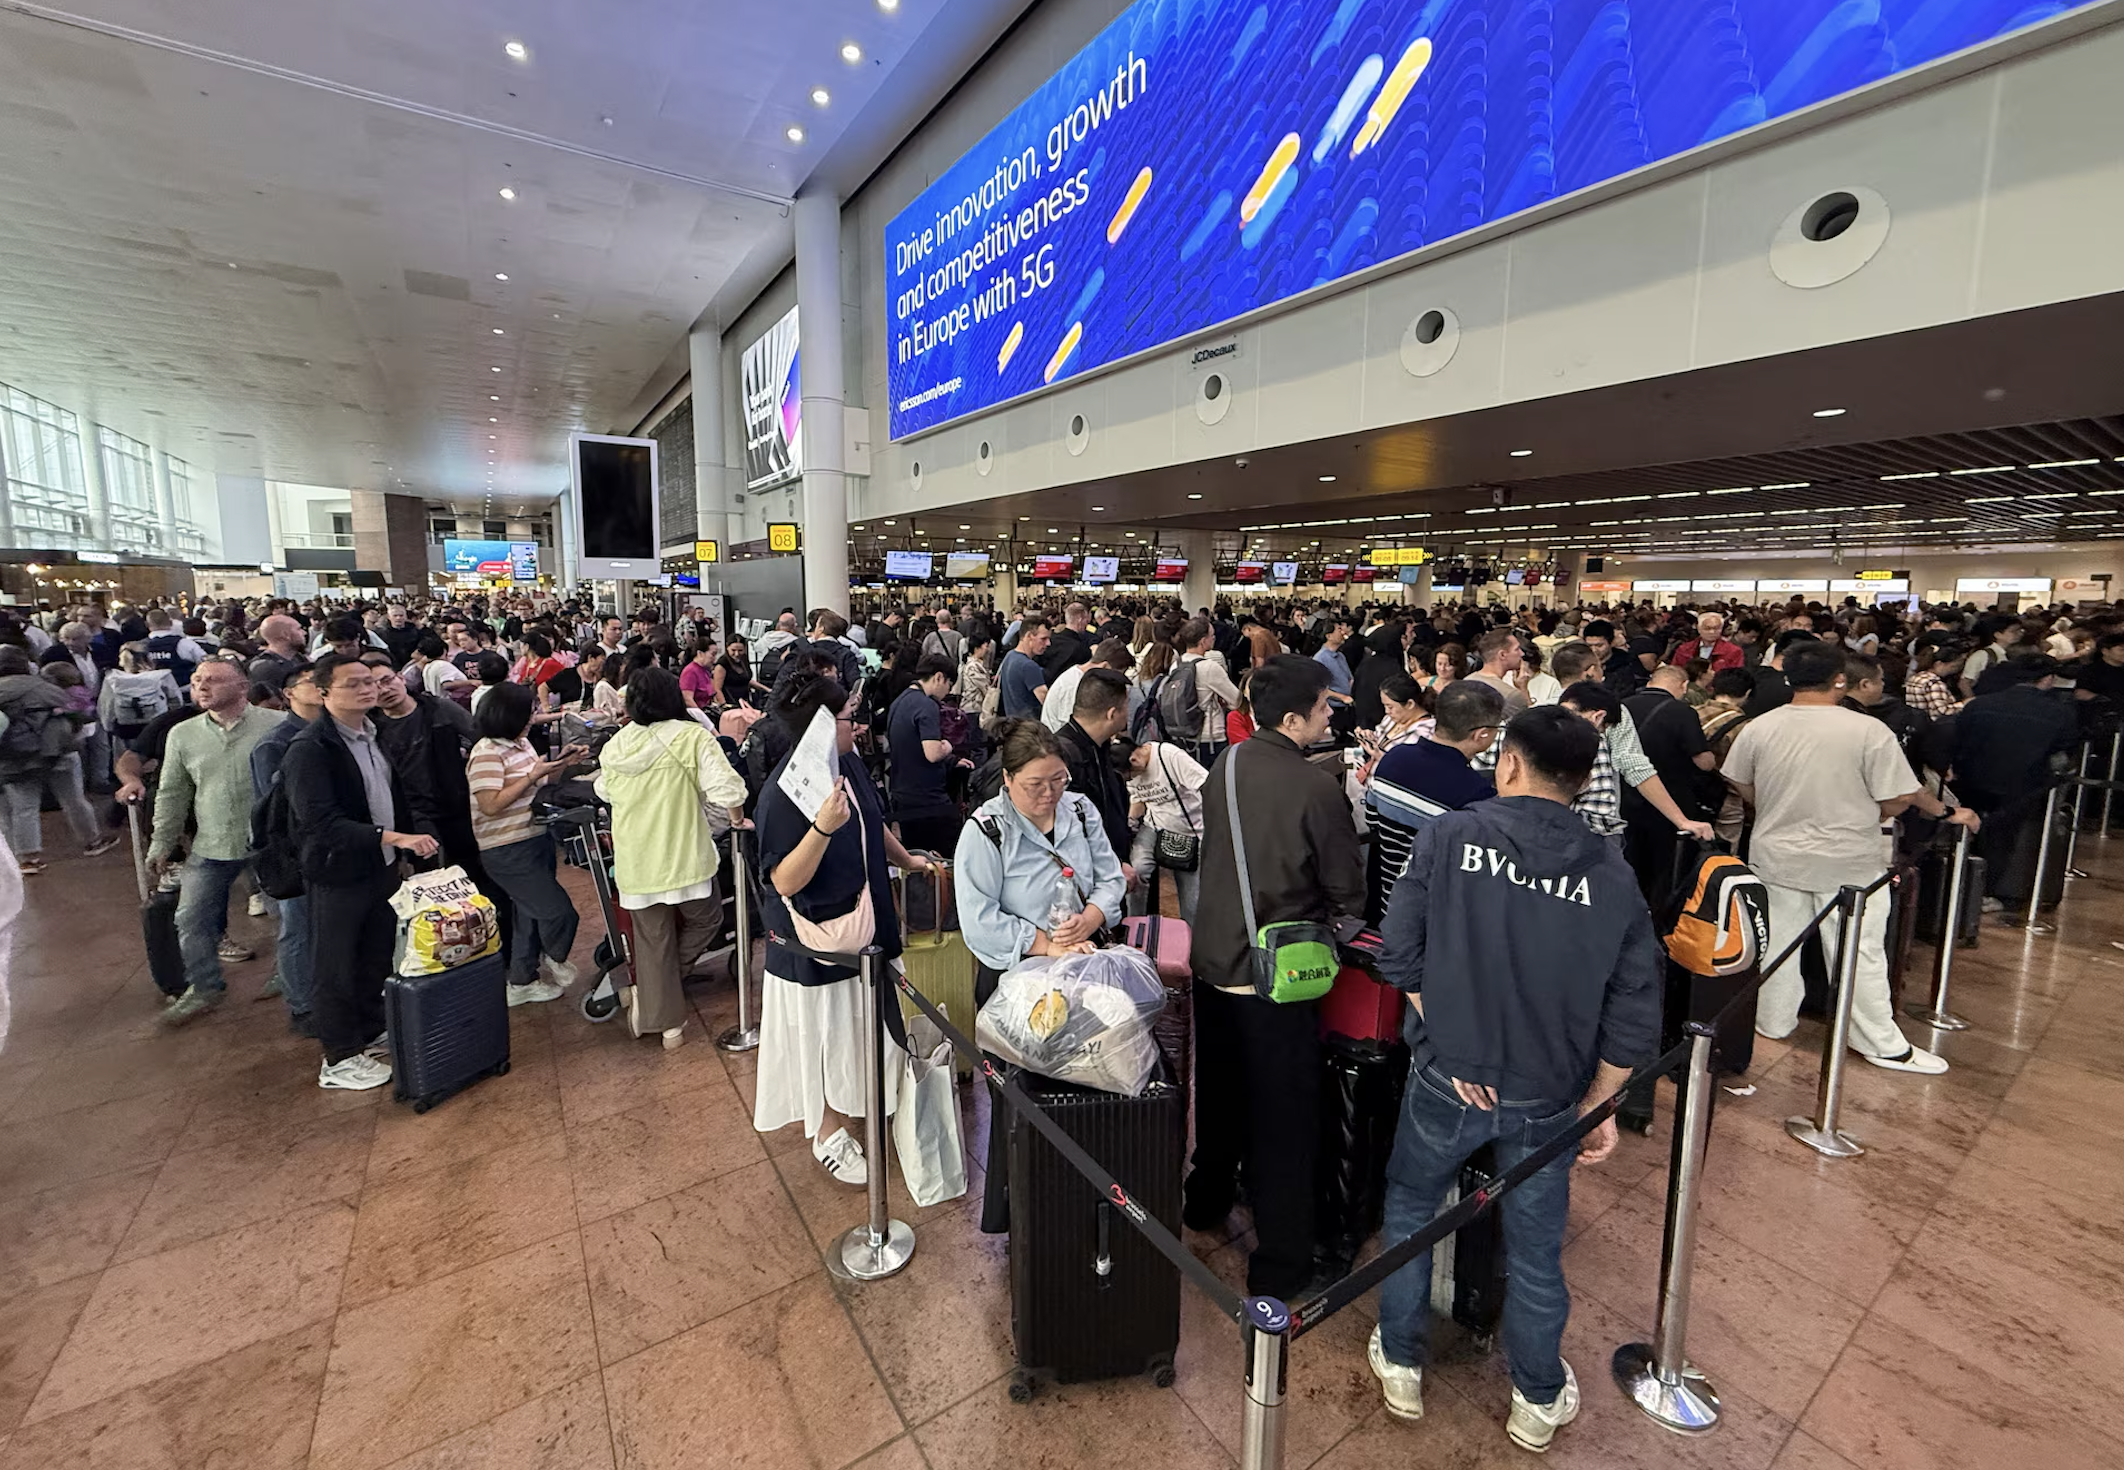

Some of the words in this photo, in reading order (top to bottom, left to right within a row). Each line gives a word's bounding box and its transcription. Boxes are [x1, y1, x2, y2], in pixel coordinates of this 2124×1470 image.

[896, 228, 933, 276] Drive
[936, 146, 1042, 247] innovation,
[1047, 50, 1147, 173] growth
[897, 274, 925, 320] and
[927, 168, 1090, 301] competitiveness
[898, 333, 912, 365] in
[914, 303, 970, 357] Europe
[973, 268, 1016, 324] with
[1021, 243, 1055, 298] 5G
[1191, 343, 1237, 364] JCDecaux
[899, 375, 962, 413] ericsson.com/europe
[698, 548, 713, 559] 07
[774, 534, 792, 547] 08
